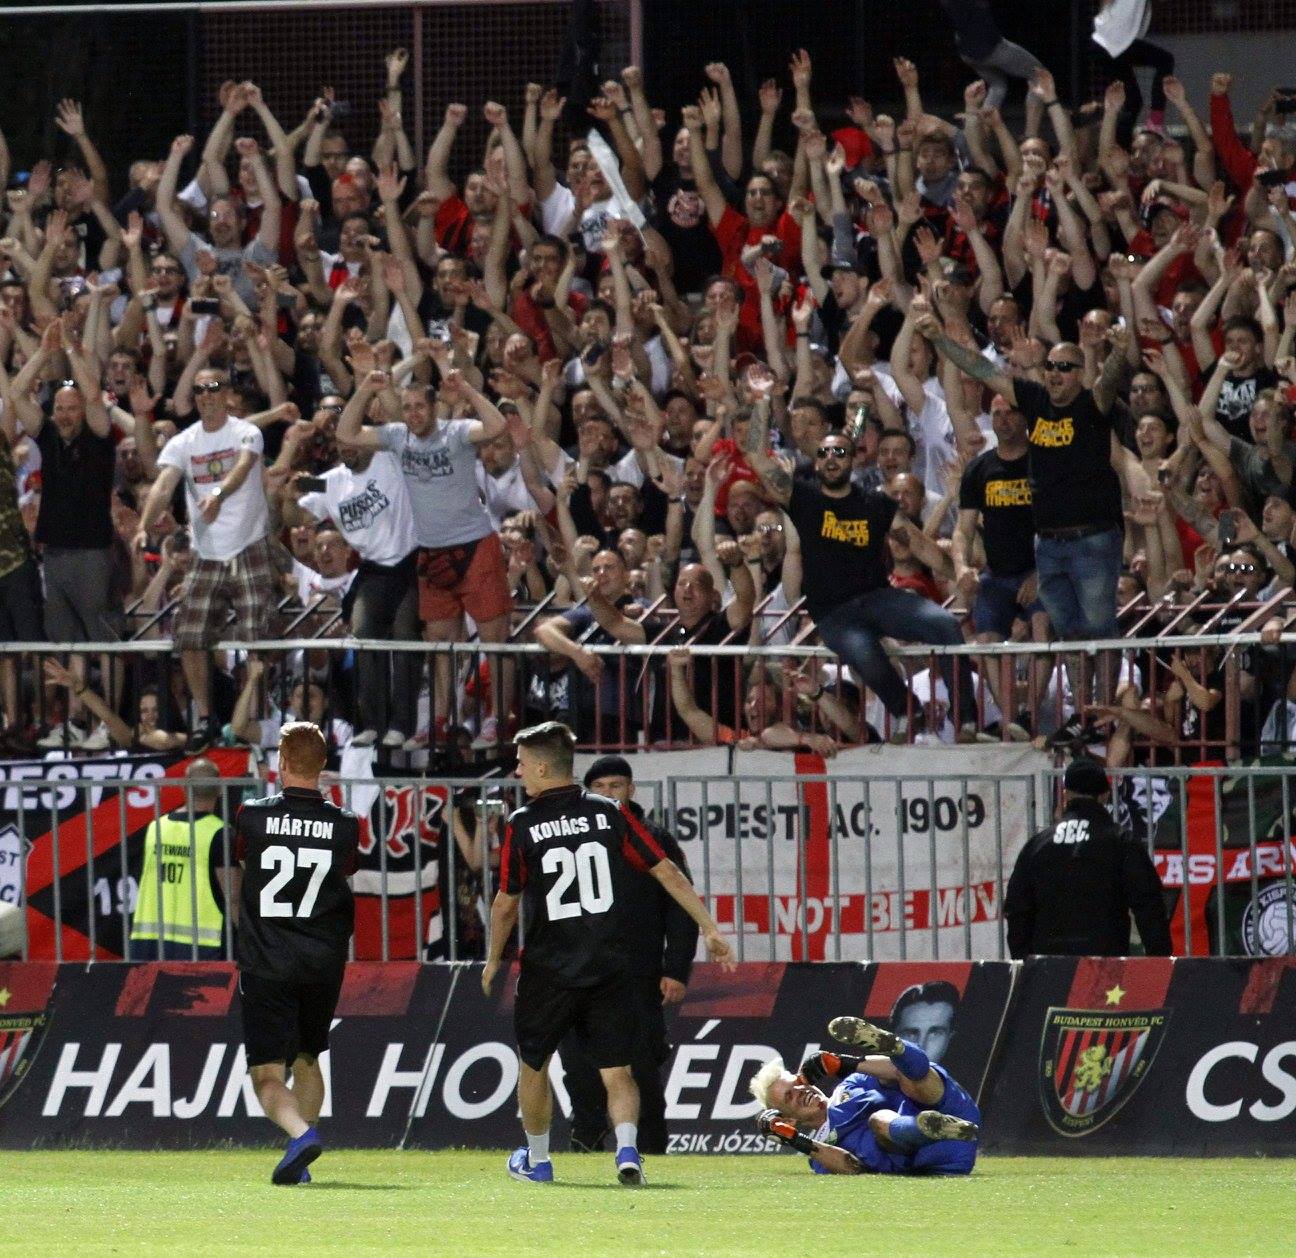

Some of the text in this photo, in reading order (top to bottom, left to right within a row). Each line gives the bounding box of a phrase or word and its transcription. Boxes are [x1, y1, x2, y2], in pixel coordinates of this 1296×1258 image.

[266, 814, 334, 839] MÁRTON
[529, 814, 611, 843] KOVÁCS D.
[646, 804, 810, 842] ISPESTI
[895, 794, 986, 834] 1909
[1054, 819, 1090, 844] SEC.
[260, 846, 332, 917] 27
[541, 841, 614, 921] 20
[773, 897, 850, 934] NOT
[864, 894, 914, 931] BE
[928, 881, 1004, 927] MOV
[665, 1133, 712, 1154] ZSIK
